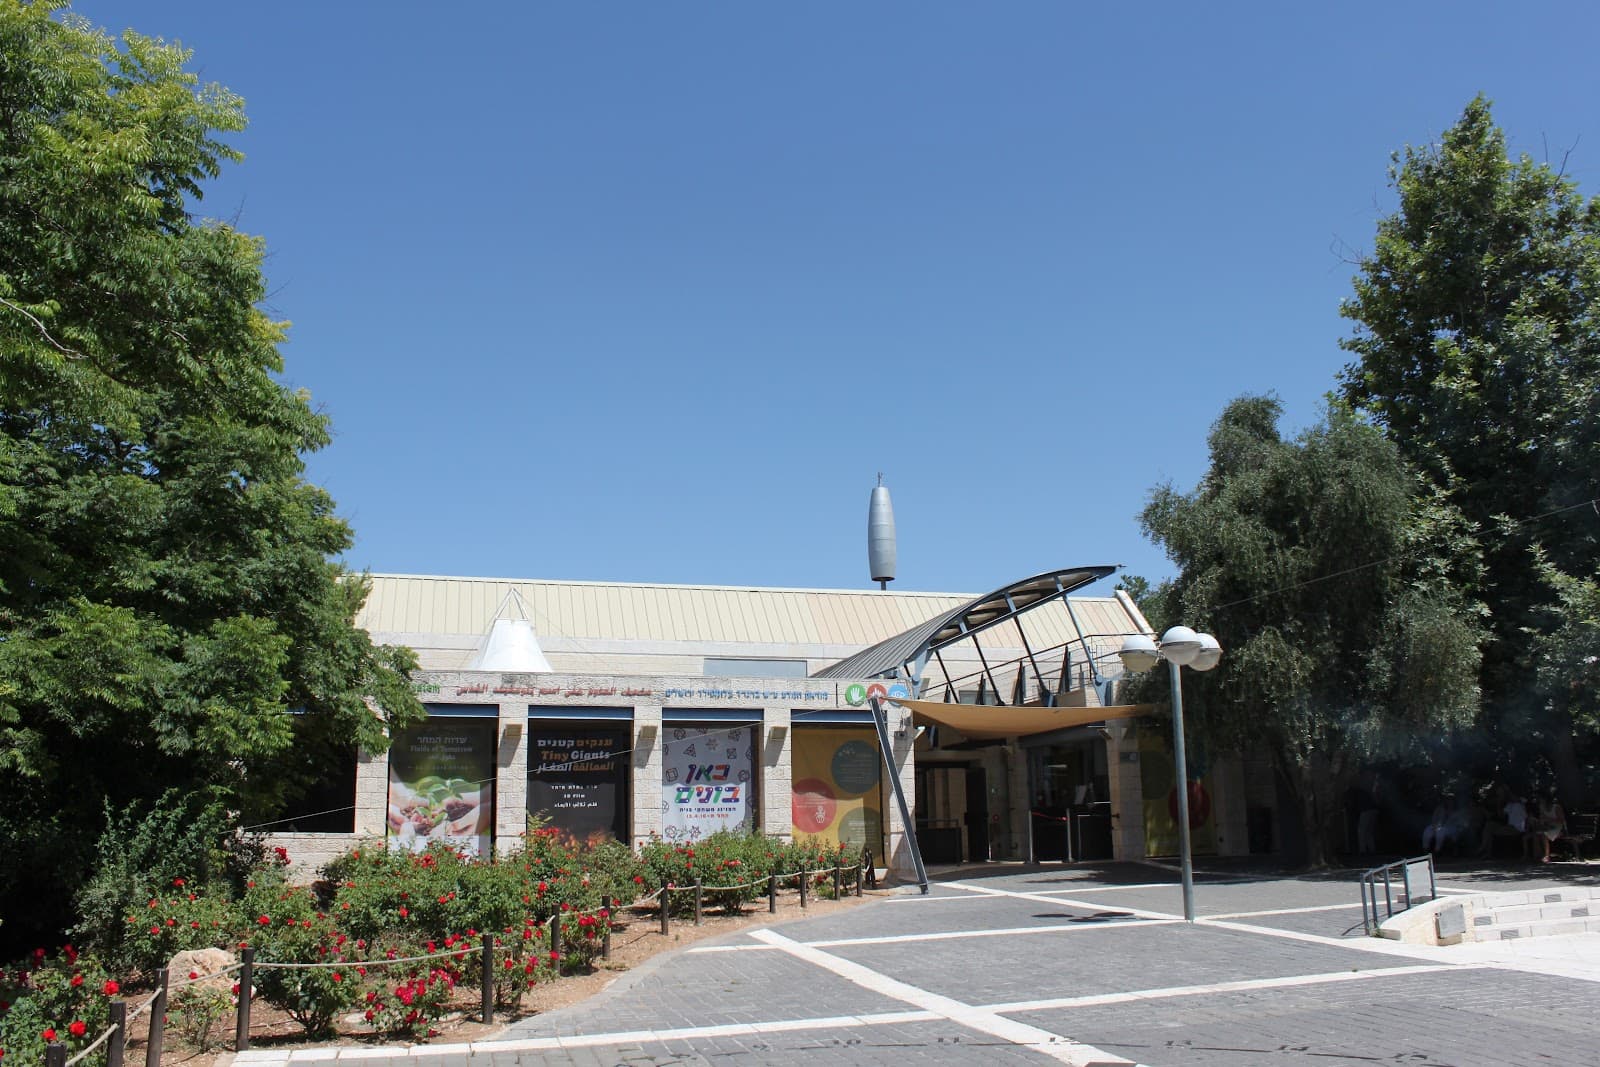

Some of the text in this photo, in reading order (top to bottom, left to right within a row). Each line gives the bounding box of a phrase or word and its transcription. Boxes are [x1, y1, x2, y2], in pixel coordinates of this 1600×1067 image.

[537, 739, 613, 748] ענקים קטנים
[541, 750, 610, 762] Tiny Giants
[685, 763, 730, 785] כאן
[674, 785, 741, 804] בונים
